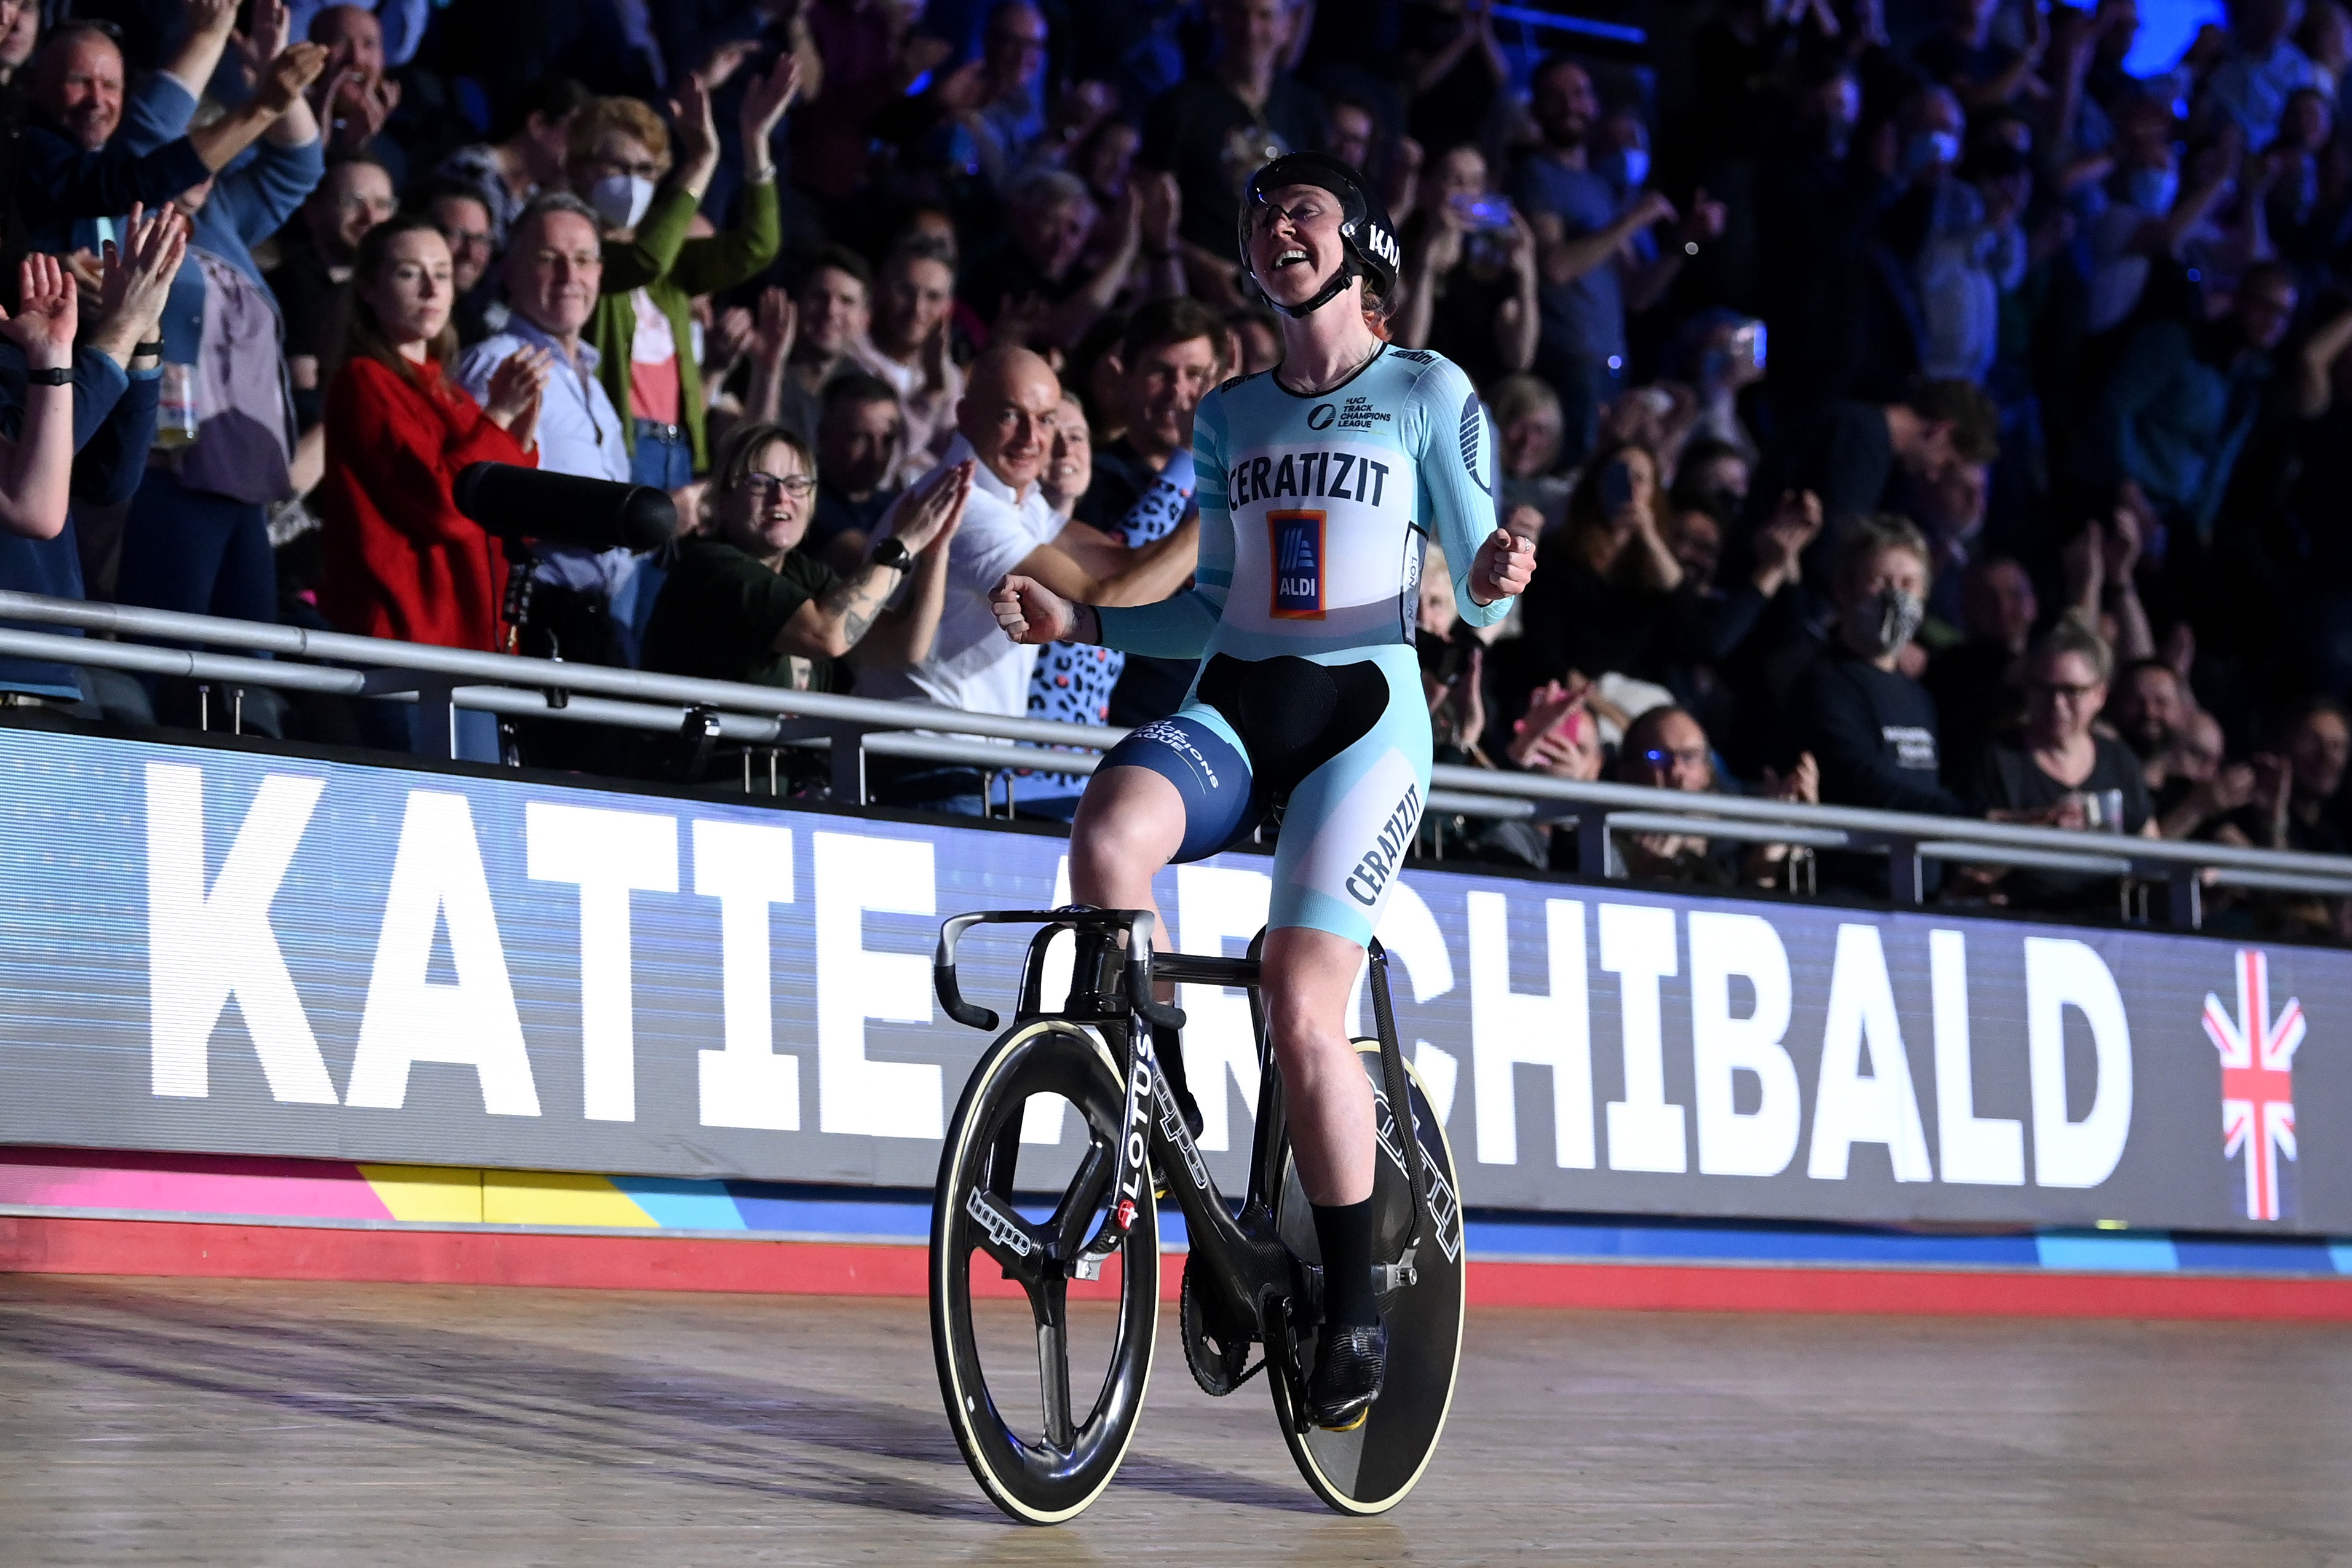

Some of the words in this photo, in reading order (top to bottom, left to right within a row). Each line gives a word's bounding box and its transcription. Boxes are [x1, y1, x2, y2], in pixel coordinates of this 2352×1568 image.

[1388, 350, 1439, 365] santini
[1340, 412, 1391, 422] CHAMPIONS
[1343, 404, 1374, 413] TRACK
[1229, 452, 1389, 512] CERATIZIT
[1279, 577, 1315, 596] ALDI
[1345, 783, 1419, 906] CERATIZIT
[145, 762, 944, 1140] KATIE
[1122, 1033, 1154, 1200] LOTUS
[1153, 1070, 1208, 1189] ope
[966, 1186, 1031, 1257] hope
